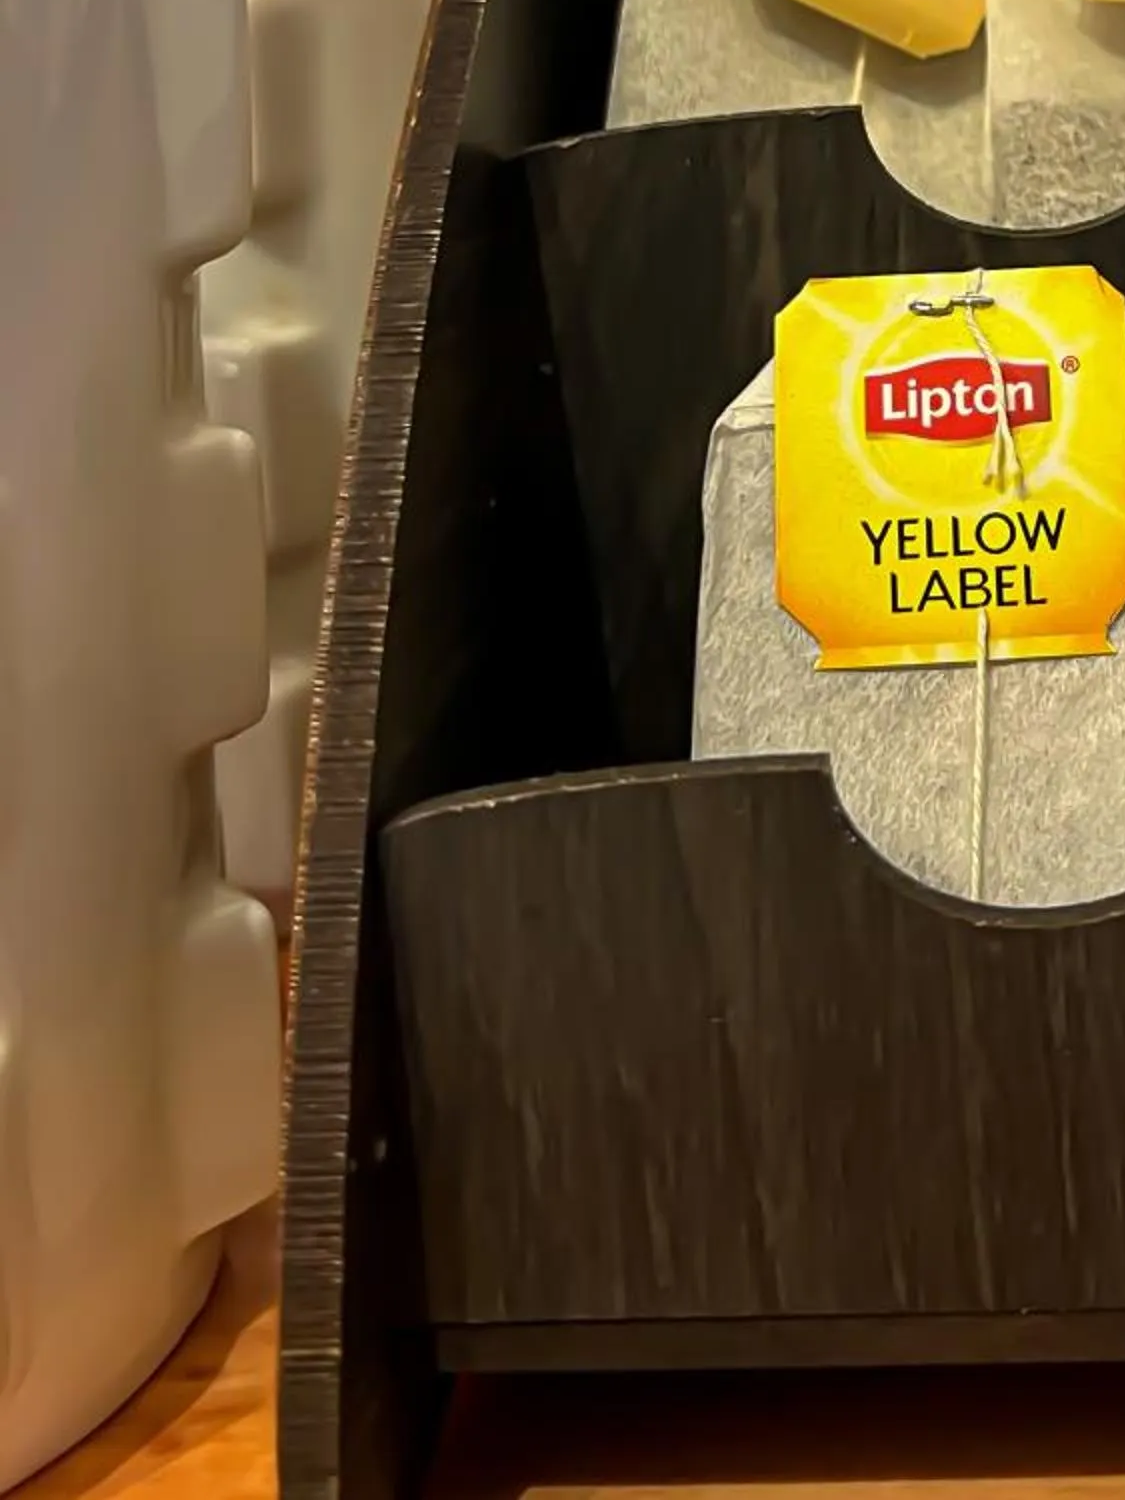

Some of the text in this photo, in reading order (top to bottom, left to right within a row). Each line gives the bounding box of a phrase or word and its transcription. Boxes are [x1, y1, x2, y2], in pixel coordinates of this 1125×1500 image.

[881, 378, 1035, 428] Lipton
[860, 508, 1066, 565] YELLOW
[889, 564, 1048, 614] LABEL
